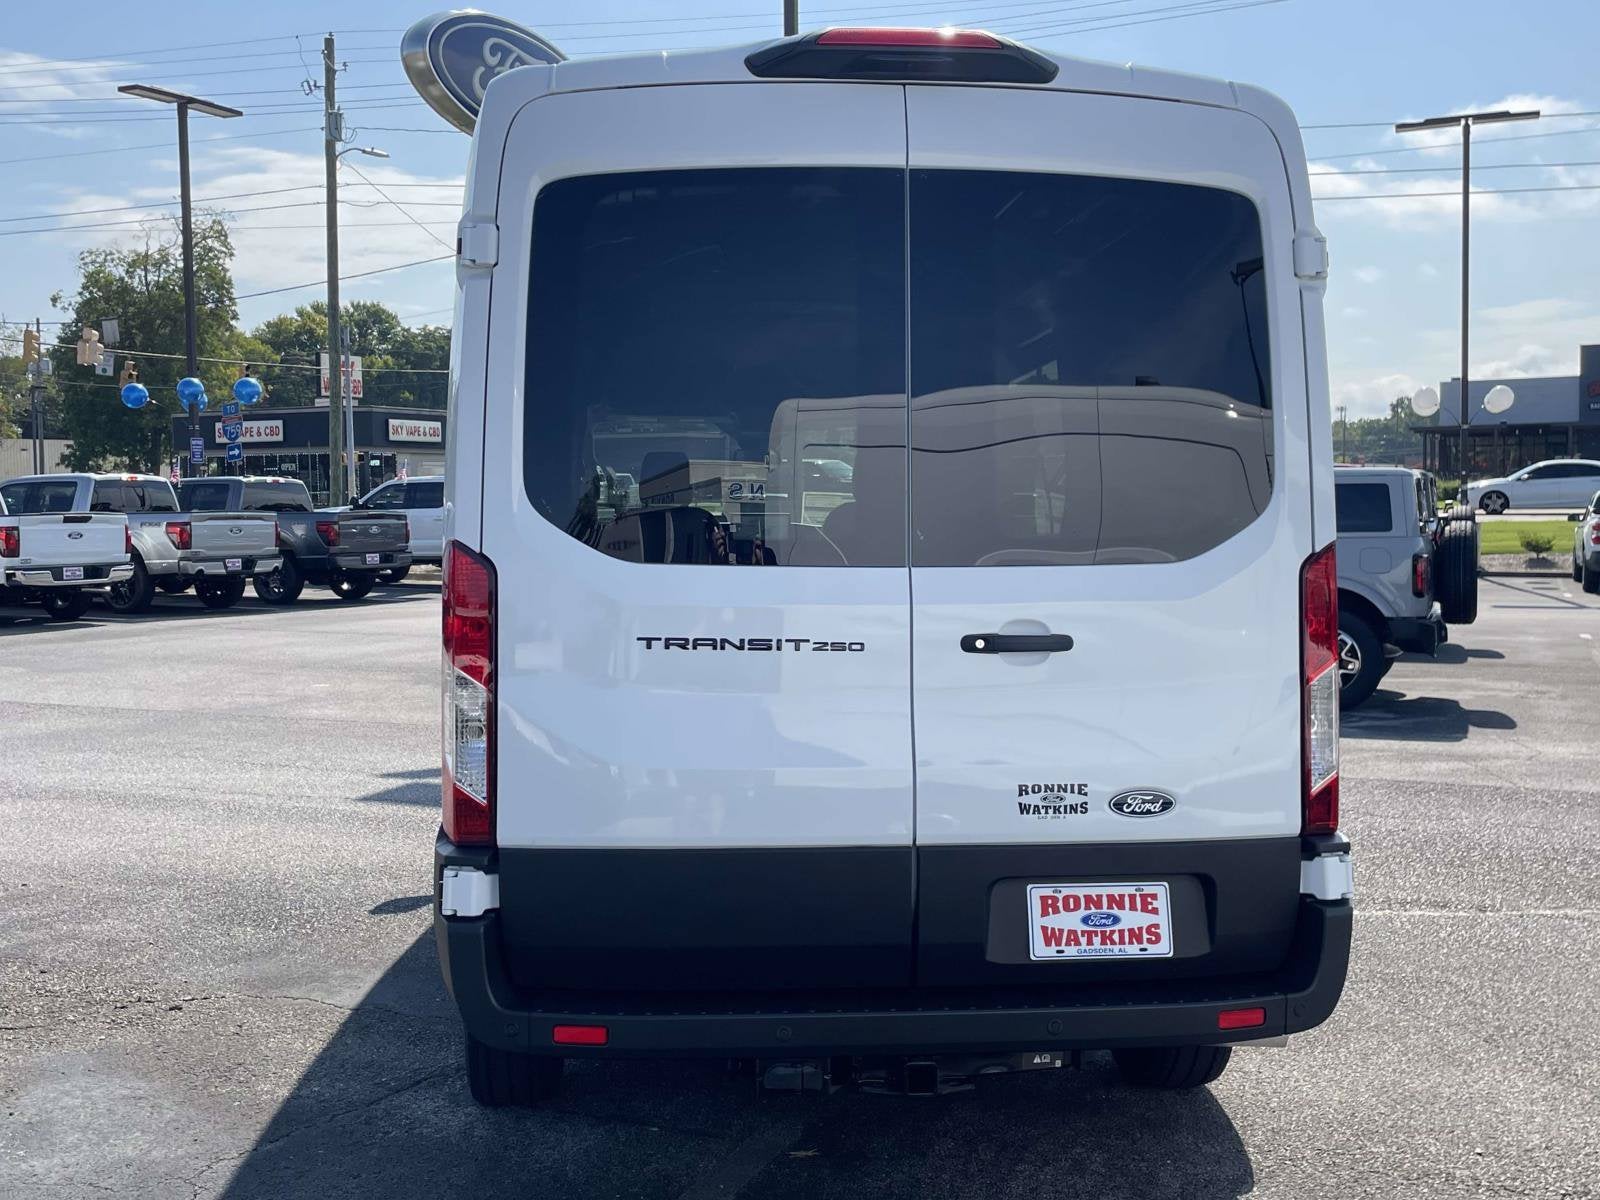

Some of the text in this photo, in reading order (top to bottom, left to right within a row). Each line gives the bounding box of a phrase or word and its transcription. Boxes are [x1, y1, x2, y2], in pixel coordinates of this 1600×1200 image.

[226, 405, 236, 413] TO
[224, 424, 241, 438] 759
[239, 425, 280, 438] APE & CBD
[391, 424, 441, 438] SKY VAPE & CBD
[636, 636, 811, 652] TRANSIT
[1017, 783, 1089, 797] RONNIE
[1017, 801, 1089, 816] WATKINS
[1122, 794, 1163, 813] Ford
[1039, 893, 1160, 918] RONNIE
[1087, 913, 1114, 926] Ford
[1040, 923, 1162, 948] WATKINS
